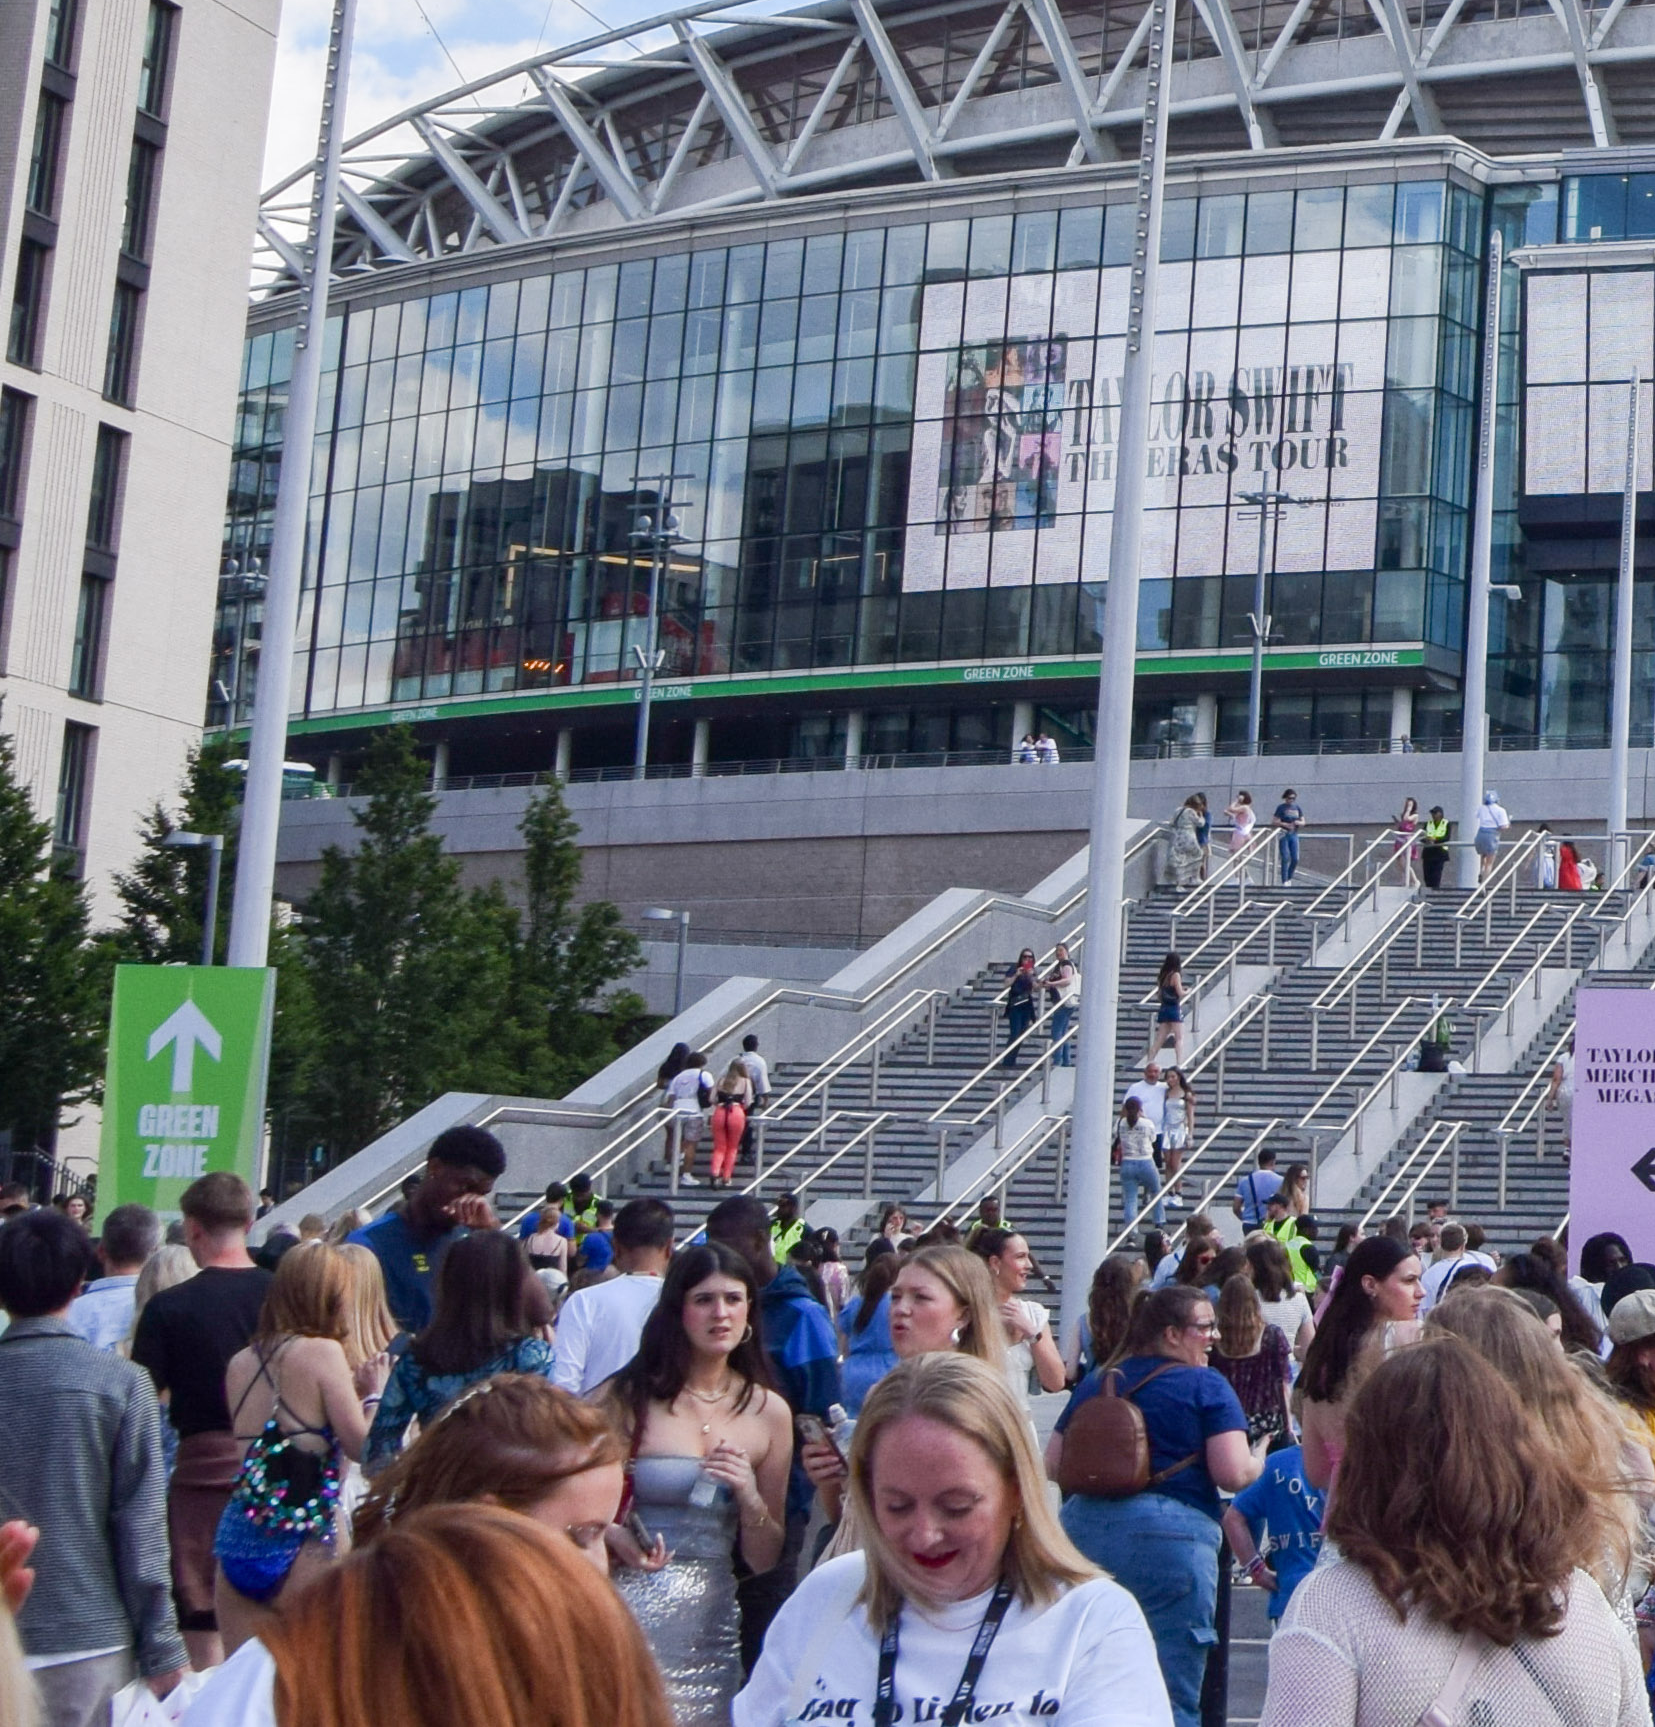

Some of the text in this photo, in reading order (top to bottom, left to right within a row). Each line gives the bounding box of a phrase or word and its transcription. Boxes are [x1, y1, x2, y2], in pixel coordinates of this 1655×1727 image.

[1226, 362, 1354, 438] SWIFT
[1065, 437, 1349, 482] TH ERAS TOUR
[964, 666, 1034, 680] GREEN ZONE
[1319, 652, 1398, 665] GREEN ZONE
[666, 685, 691, 697] ZONE
[138, 1104, 219, 1138] GREEN
[143, 1144, 209, 1177] ZONE
